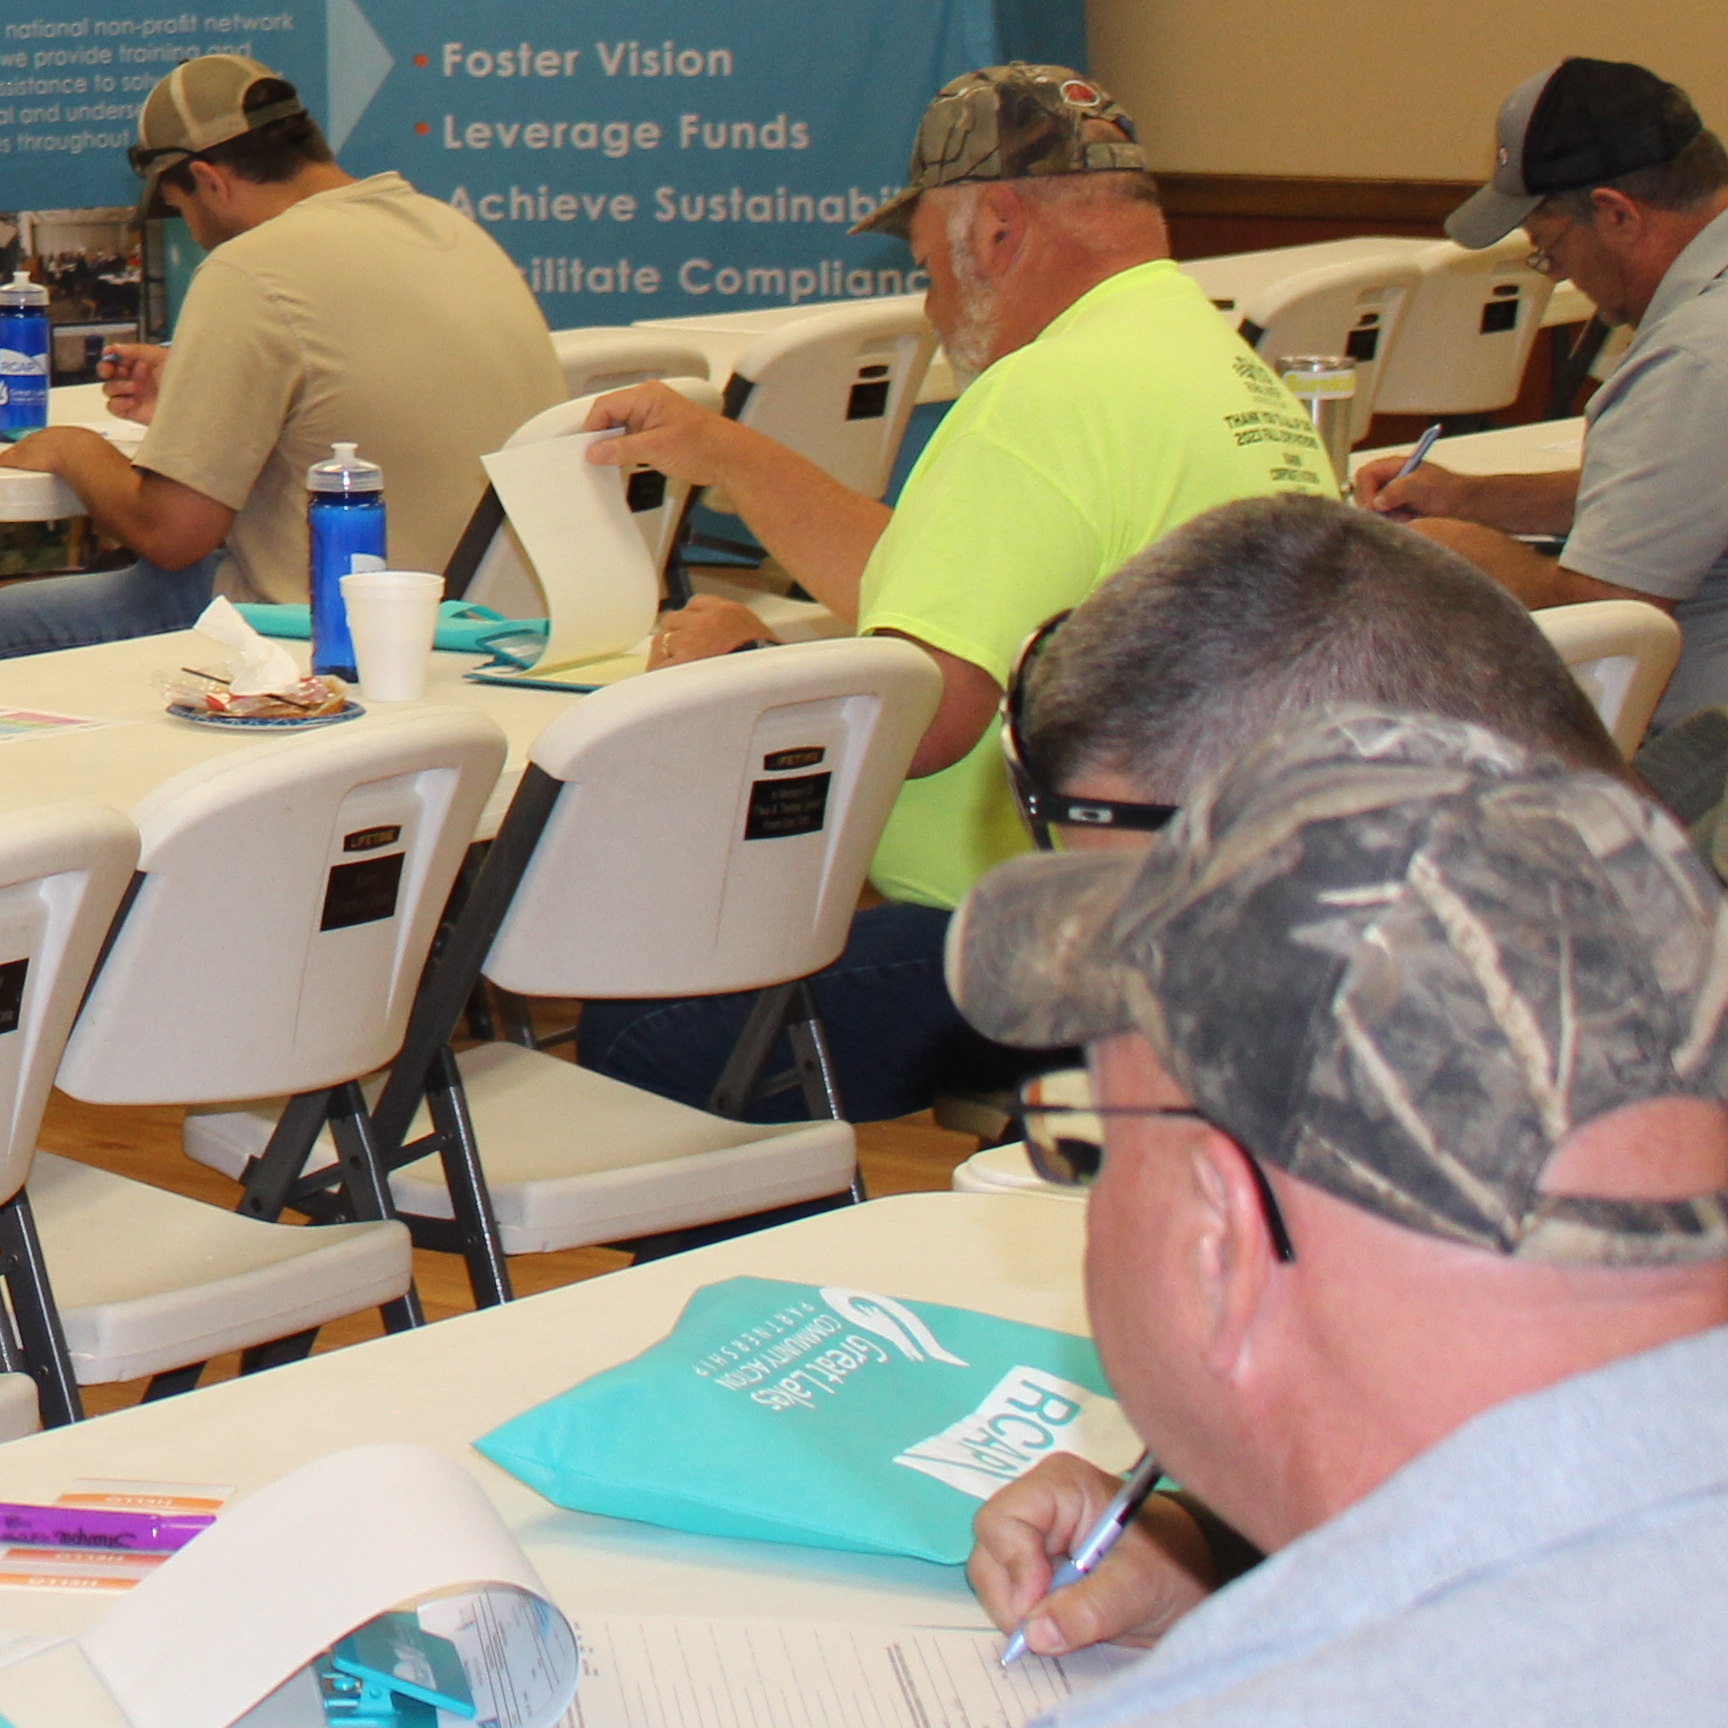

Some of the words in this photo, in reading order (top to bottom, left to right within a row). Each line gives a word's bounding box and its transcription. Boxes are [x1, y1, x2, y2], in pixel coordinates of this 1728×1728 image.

[5, 19, 90, 40] national
[94, 14, 198, 41] non-profit
[204, 12, 295, 33] network
[0, 52, 28, 68] we
[33, 45, 113, 70] provide
[119, 41, 203, 64] training
[443, 41, 580, 78] Foster
[596, 40, 734, 77] Vision
[94, 73, 116, 93] to
[19, 102, 60, 124] and
[17, 131, 130, 158] throughout
[444, 114, 662, 158] Leverage
[679, 113, 811, 150] Funds
[449, 185, 637, 223] Achieve
[654, 184, 894, 223] Sustainabi
[519, 256, 662, 294] ilitate
[678, 257, 929, 303] Complianc
[351, 829, 395, 848] LIFETIME
[692, 1300, 816, 1377] PARTNERSHIP
[760, 1314, 842, 1370] COMMUNITY
[714, 1357, 772, 1392] ACTION
[805, 1334, 889, 1385] Great
[750, 1369, 836, 1412] Lakes
[956, 1379, 1081, 1472] RCAP
[27, 1576, 98, 1587] HELLO
